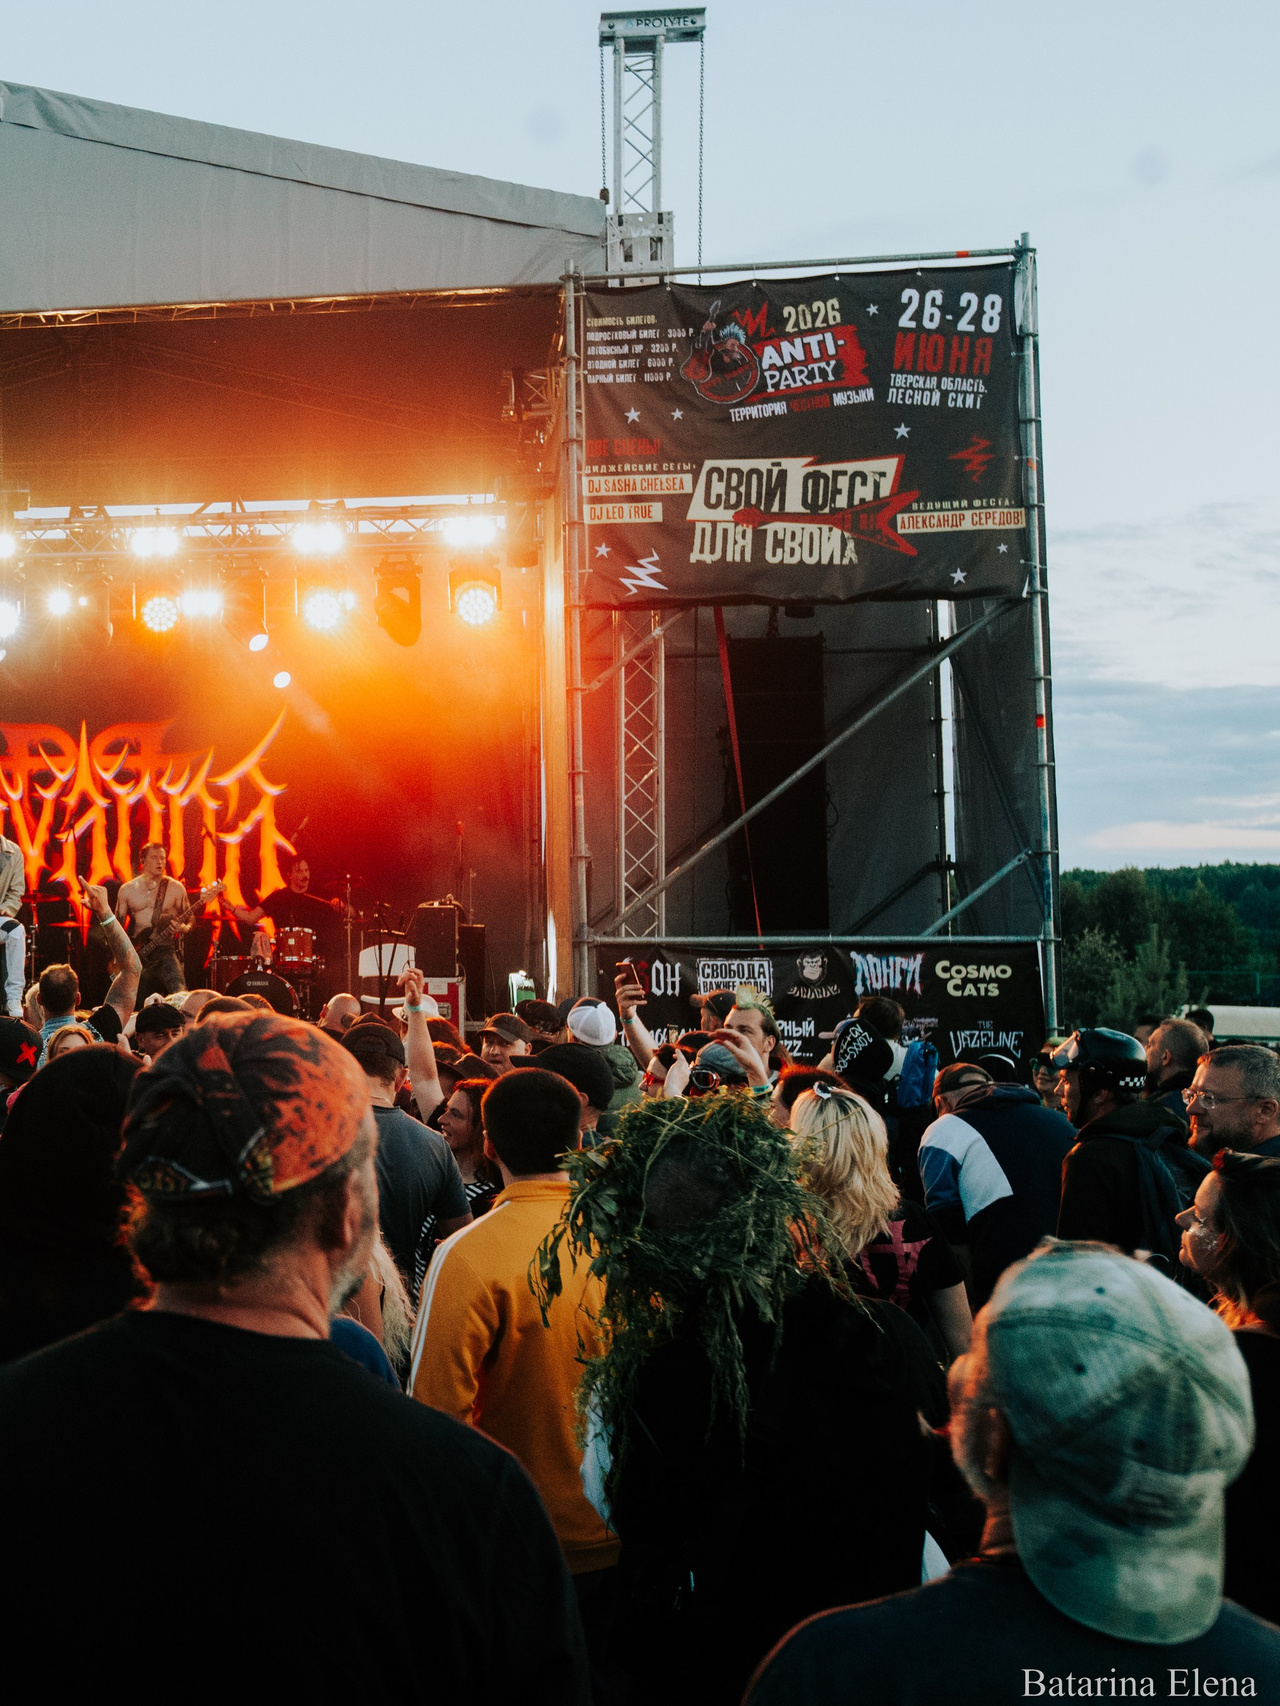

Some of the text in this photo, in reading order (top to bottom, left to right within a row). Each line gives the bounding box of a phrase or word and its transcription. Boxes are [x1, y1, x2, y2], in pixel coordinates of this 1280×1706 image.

[636, 16, 690, 28] PROLYTE
[782, 298, 842, 333] 2026
[898, 287, 1003, 333] 26-28
[761, 332, 846, 370] ANTI-
[892, 331, 994, 376] ИЮНЯ
[764, 360, 837, 393] PARTY
[890, 373, 937, 389] ТВЕРСКАЯ
[729, 401, 788, 422] ТЕРРИТОРИЯ
[832, 388, 875, 407] МУЗЫКИ
[886, 387, 983, 410] ЛЕСНОЙ СКИТ
[585, 463, 659, 473] ДИДЖЕЙСКИЕ
[588, 477, 685, 494] DJ SASHA CHELSEA
[703, 462, 887, 513] СВОЙ ФЕСТ
[589, 505, 653, 521] DJ LEO TRUE
[912, 499, 968, 510] ВЕДУЩИЙ
[900, 512, 966, 530] АЛЕКСАНДР
[689, 522, 858, 565] ДЛЯ СВОИХ
[701, 963, 767, 980] СВОБОДА
[935, 960, 1012, 981] COSMO
[702, 980, 767, 994] ВАЖНЕЕ ДЫ
[946, 979, 1000, 997] CATS
[776, 1017, 815, 1038] РНЫЙ
[977, 1020, 994, 1030] THE
